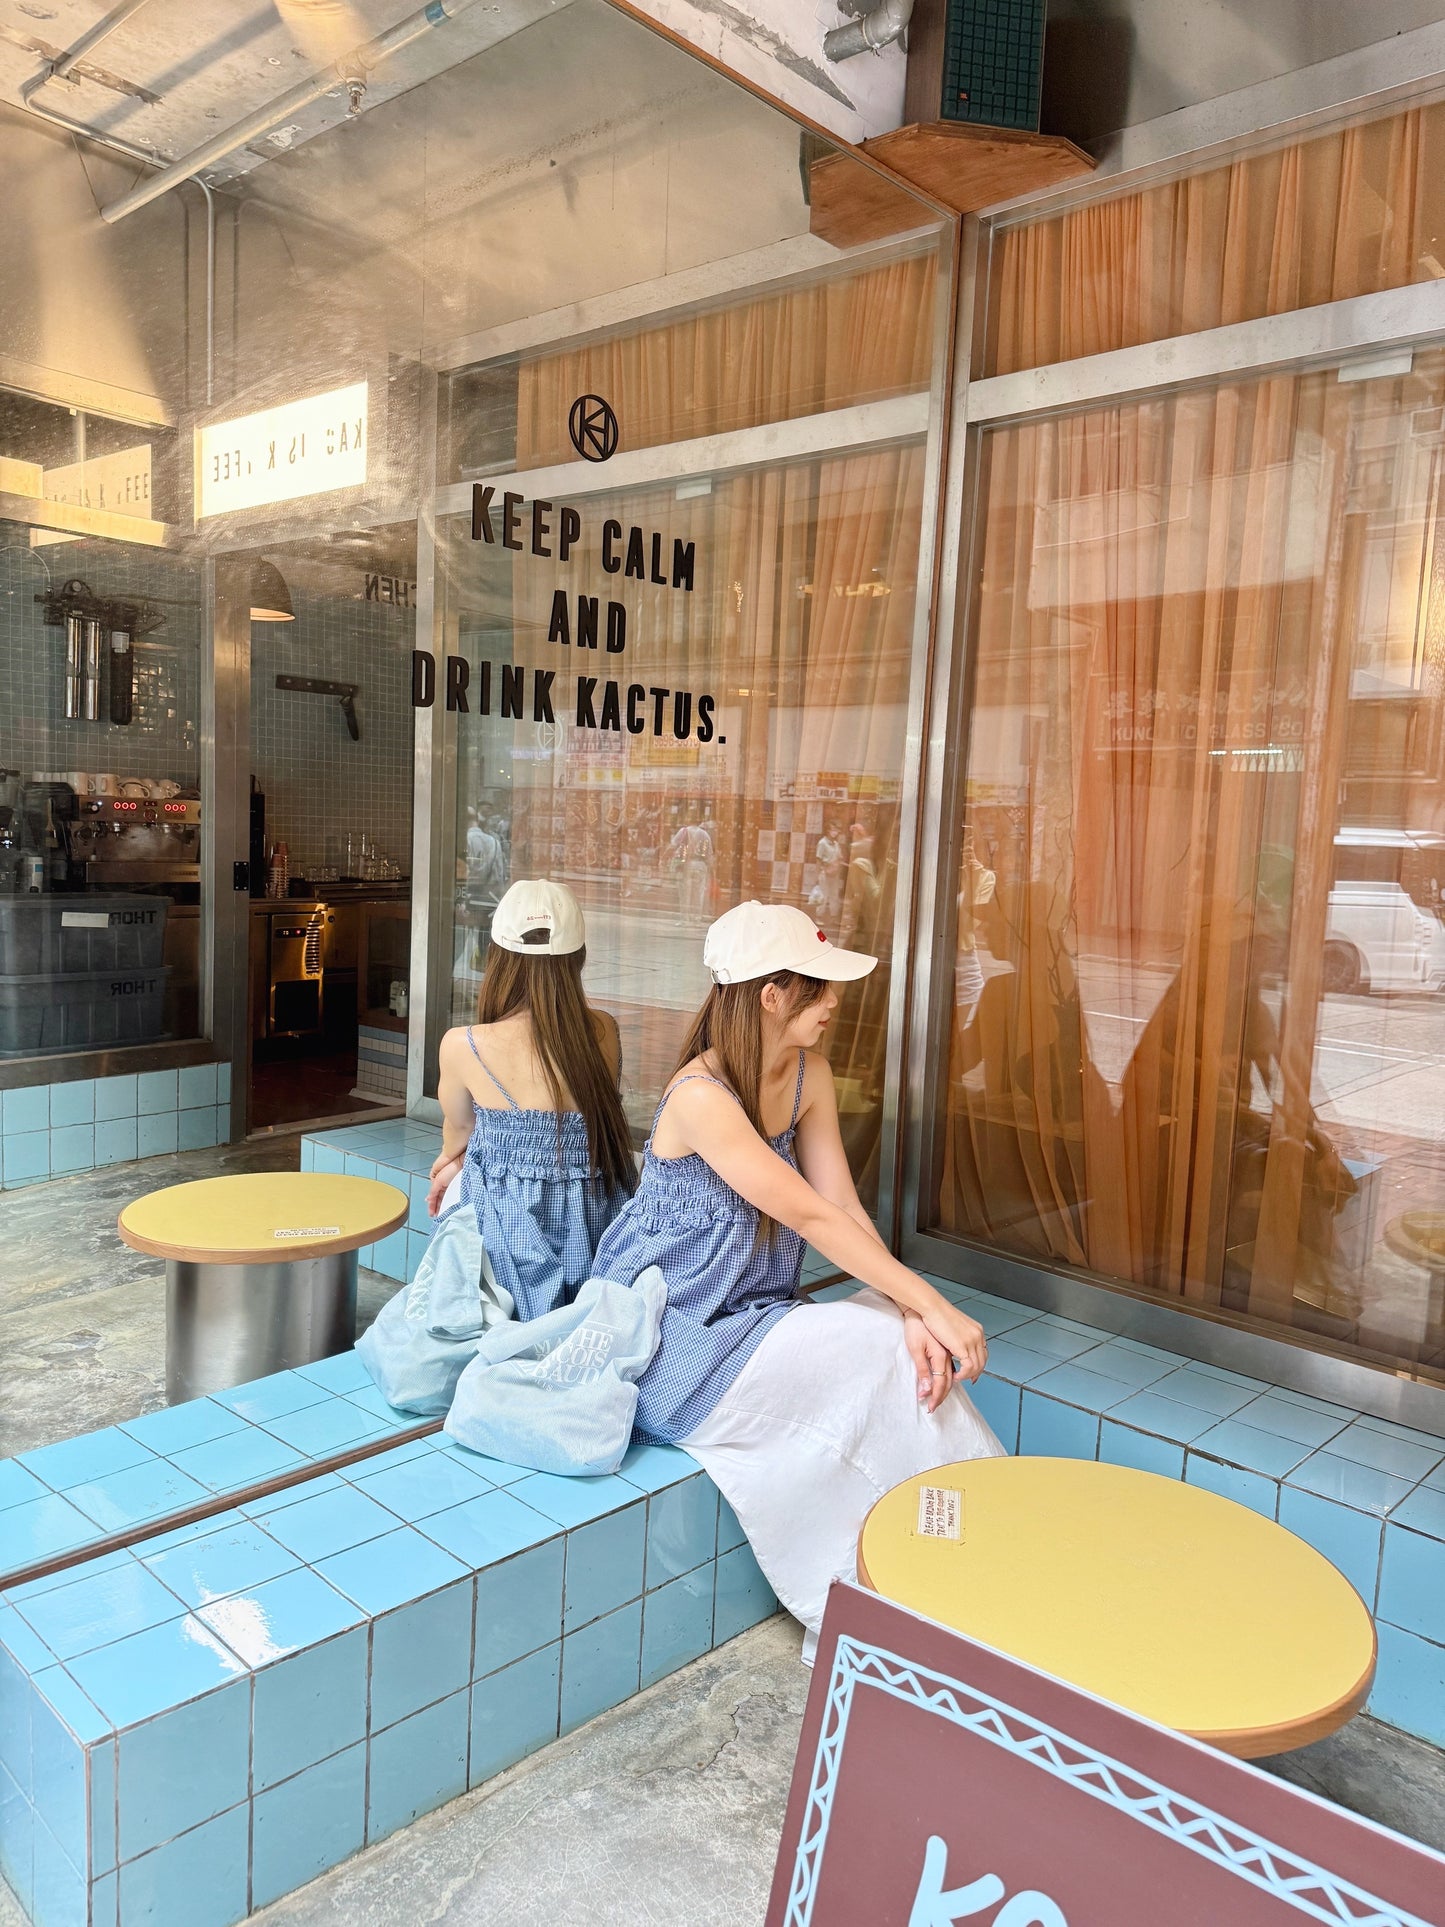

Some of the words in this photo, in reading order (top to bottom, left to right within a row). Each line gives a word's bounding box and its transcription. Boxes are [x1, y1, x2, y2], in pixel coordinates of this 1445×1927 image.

[472, 483, 581, 561] KEEP
[602, 519, 695, 591] CALM
[548, 590, 627, 653] AND
[412, 650, 556, 723] DRINK
[577, 676, 726, 744] KACTUS.
